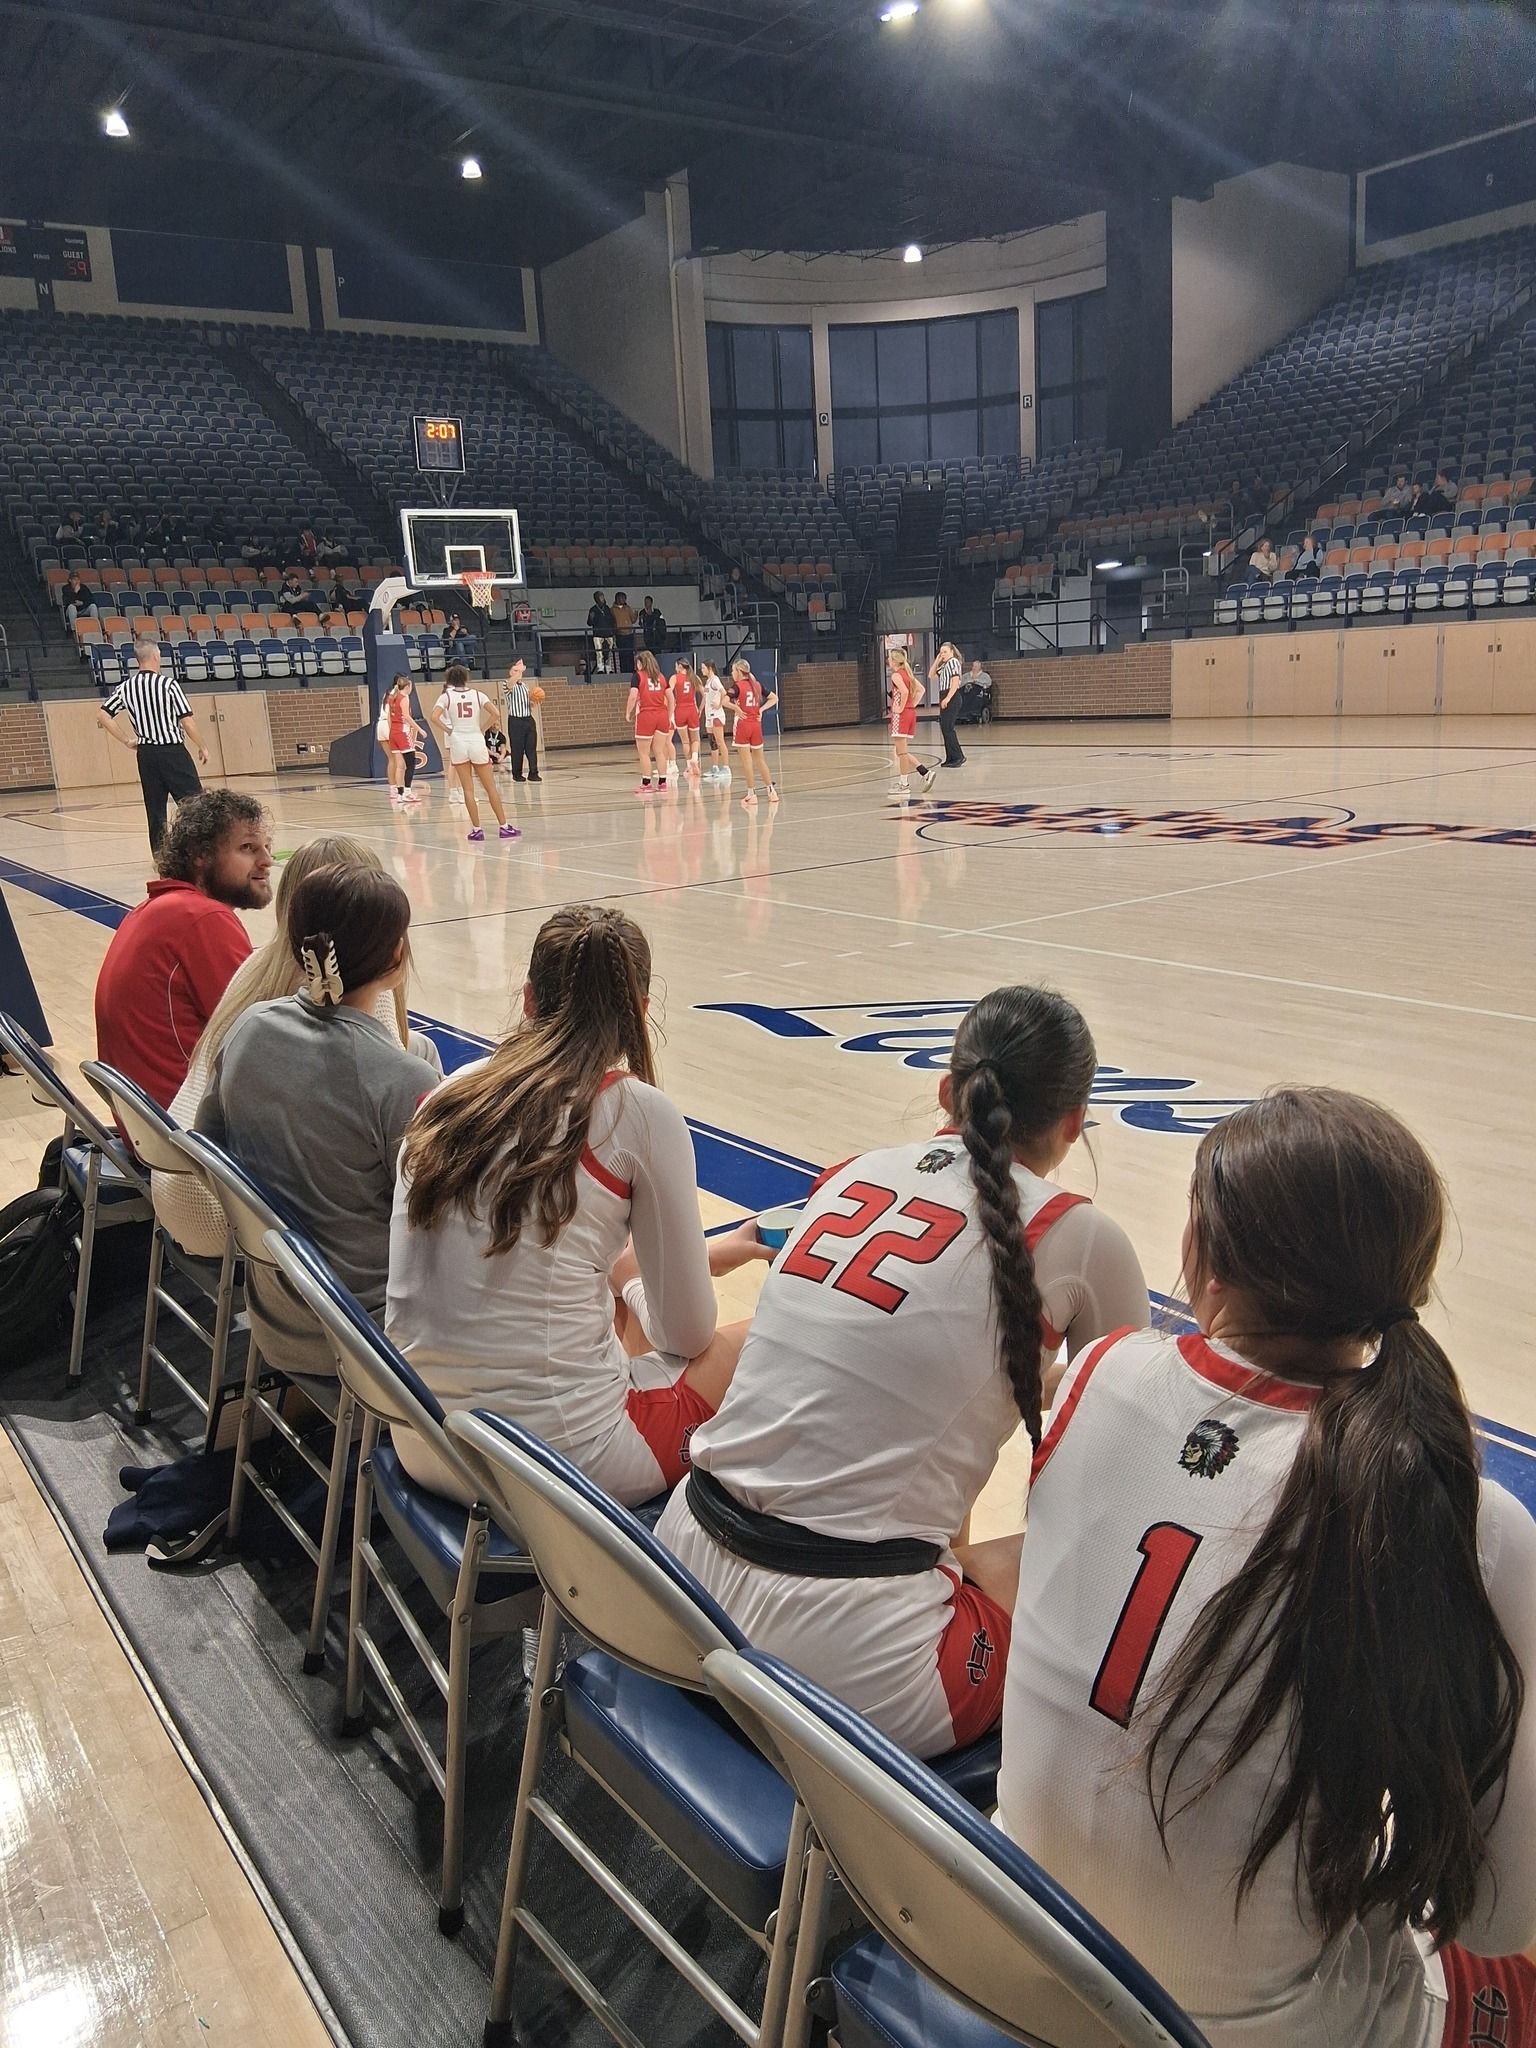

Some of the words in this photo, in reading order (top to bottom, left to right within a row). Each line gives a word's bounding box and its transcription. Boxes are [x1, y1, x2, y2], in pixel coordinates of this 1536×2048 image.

[39, 282, 49, 295] N
[1023, 395, 1032, 408] R
[819, 413, 829, 425] Q
[426, 422, 456, 439] 2:07
[702, 631, 722, 641] N-P-Q
[683, 681, 692, 694] 5
[456, 701, 473, 718] 15
[883, 811, 1387, 849] STATE
[781, 1180, 967, 1315] 22
[1088, 1520, 1203, 1730] 1
